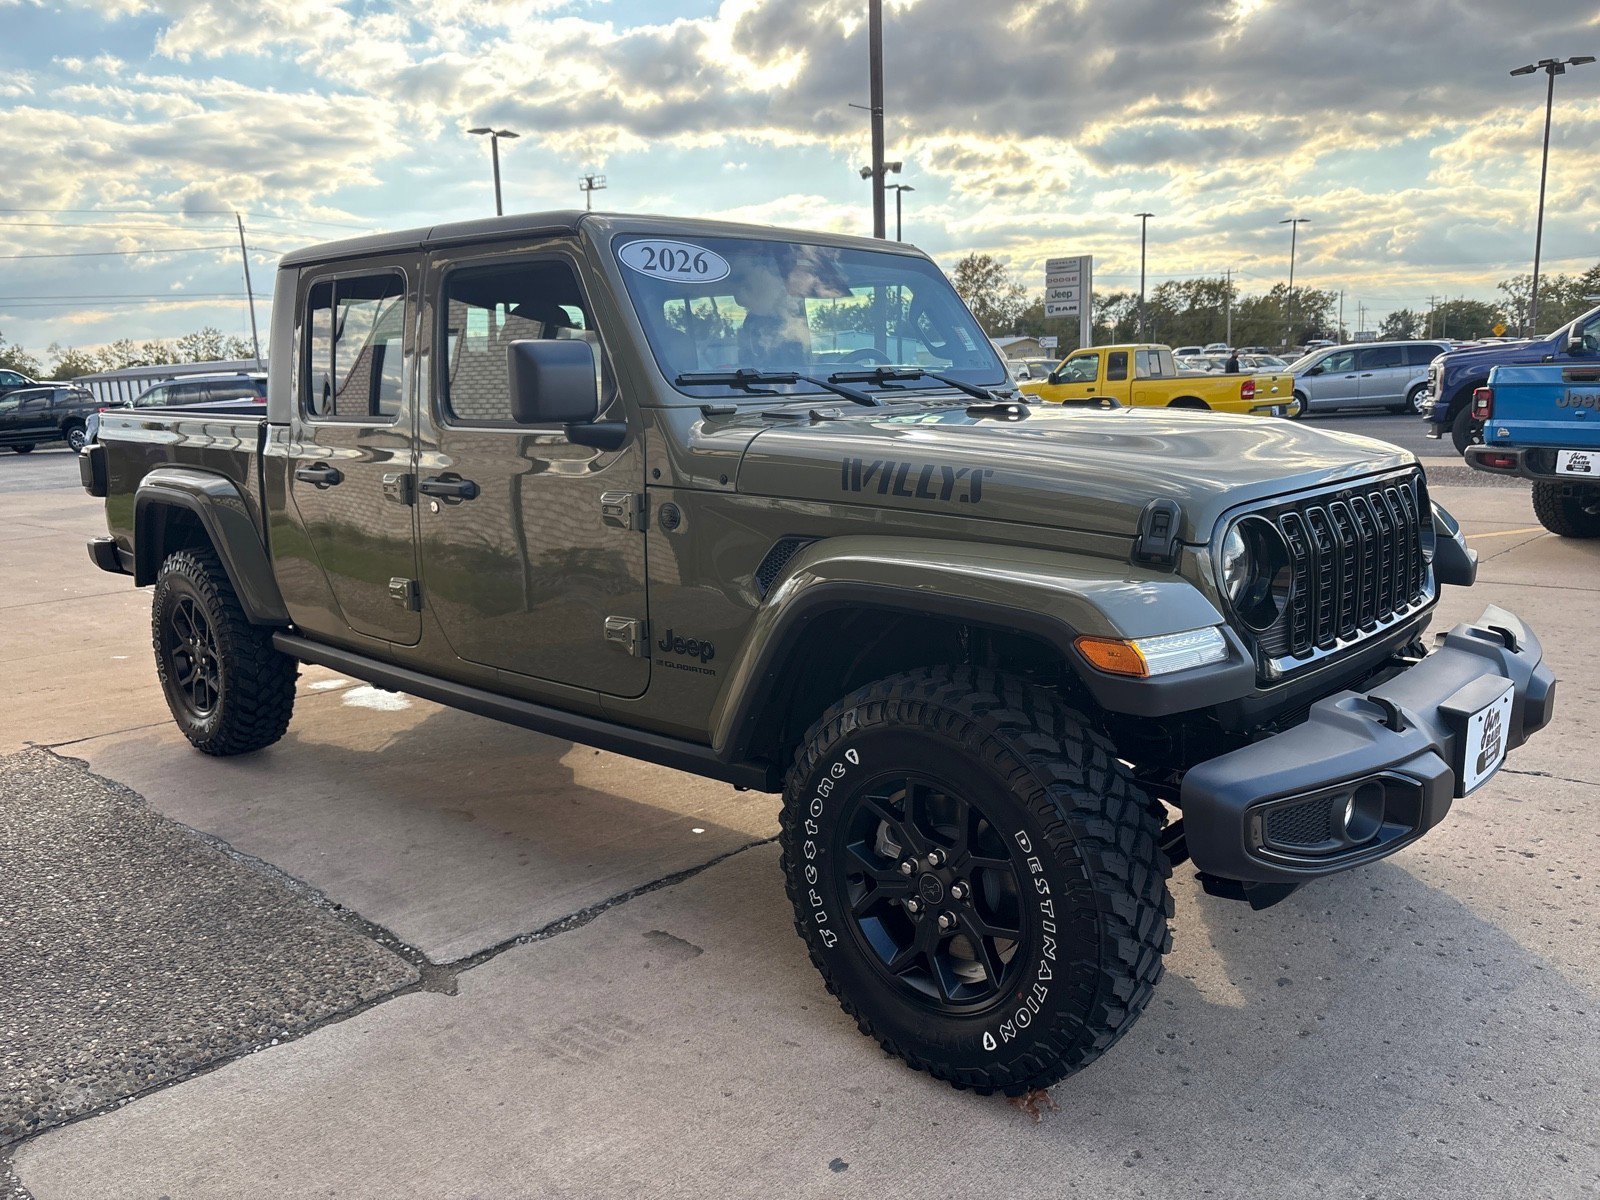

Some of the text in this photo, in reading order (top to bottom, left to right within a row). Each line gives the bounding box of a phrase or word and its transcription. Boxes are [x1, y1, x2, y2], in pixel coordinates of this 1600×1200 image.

[641, 247, 708, 274] 2026
[1051, 290, 1072, 299] Jeep
[1569, 452, 1587, 463] Jim
[842, 457, 994, 503] WILLYS
[658, 628, 715, 664] Jeep
[665, 661, 716, 676] GLADIATOR
[804, 763, 845, 947] Firestone
[1000, 830, 1056, 1043] DESTINATION
